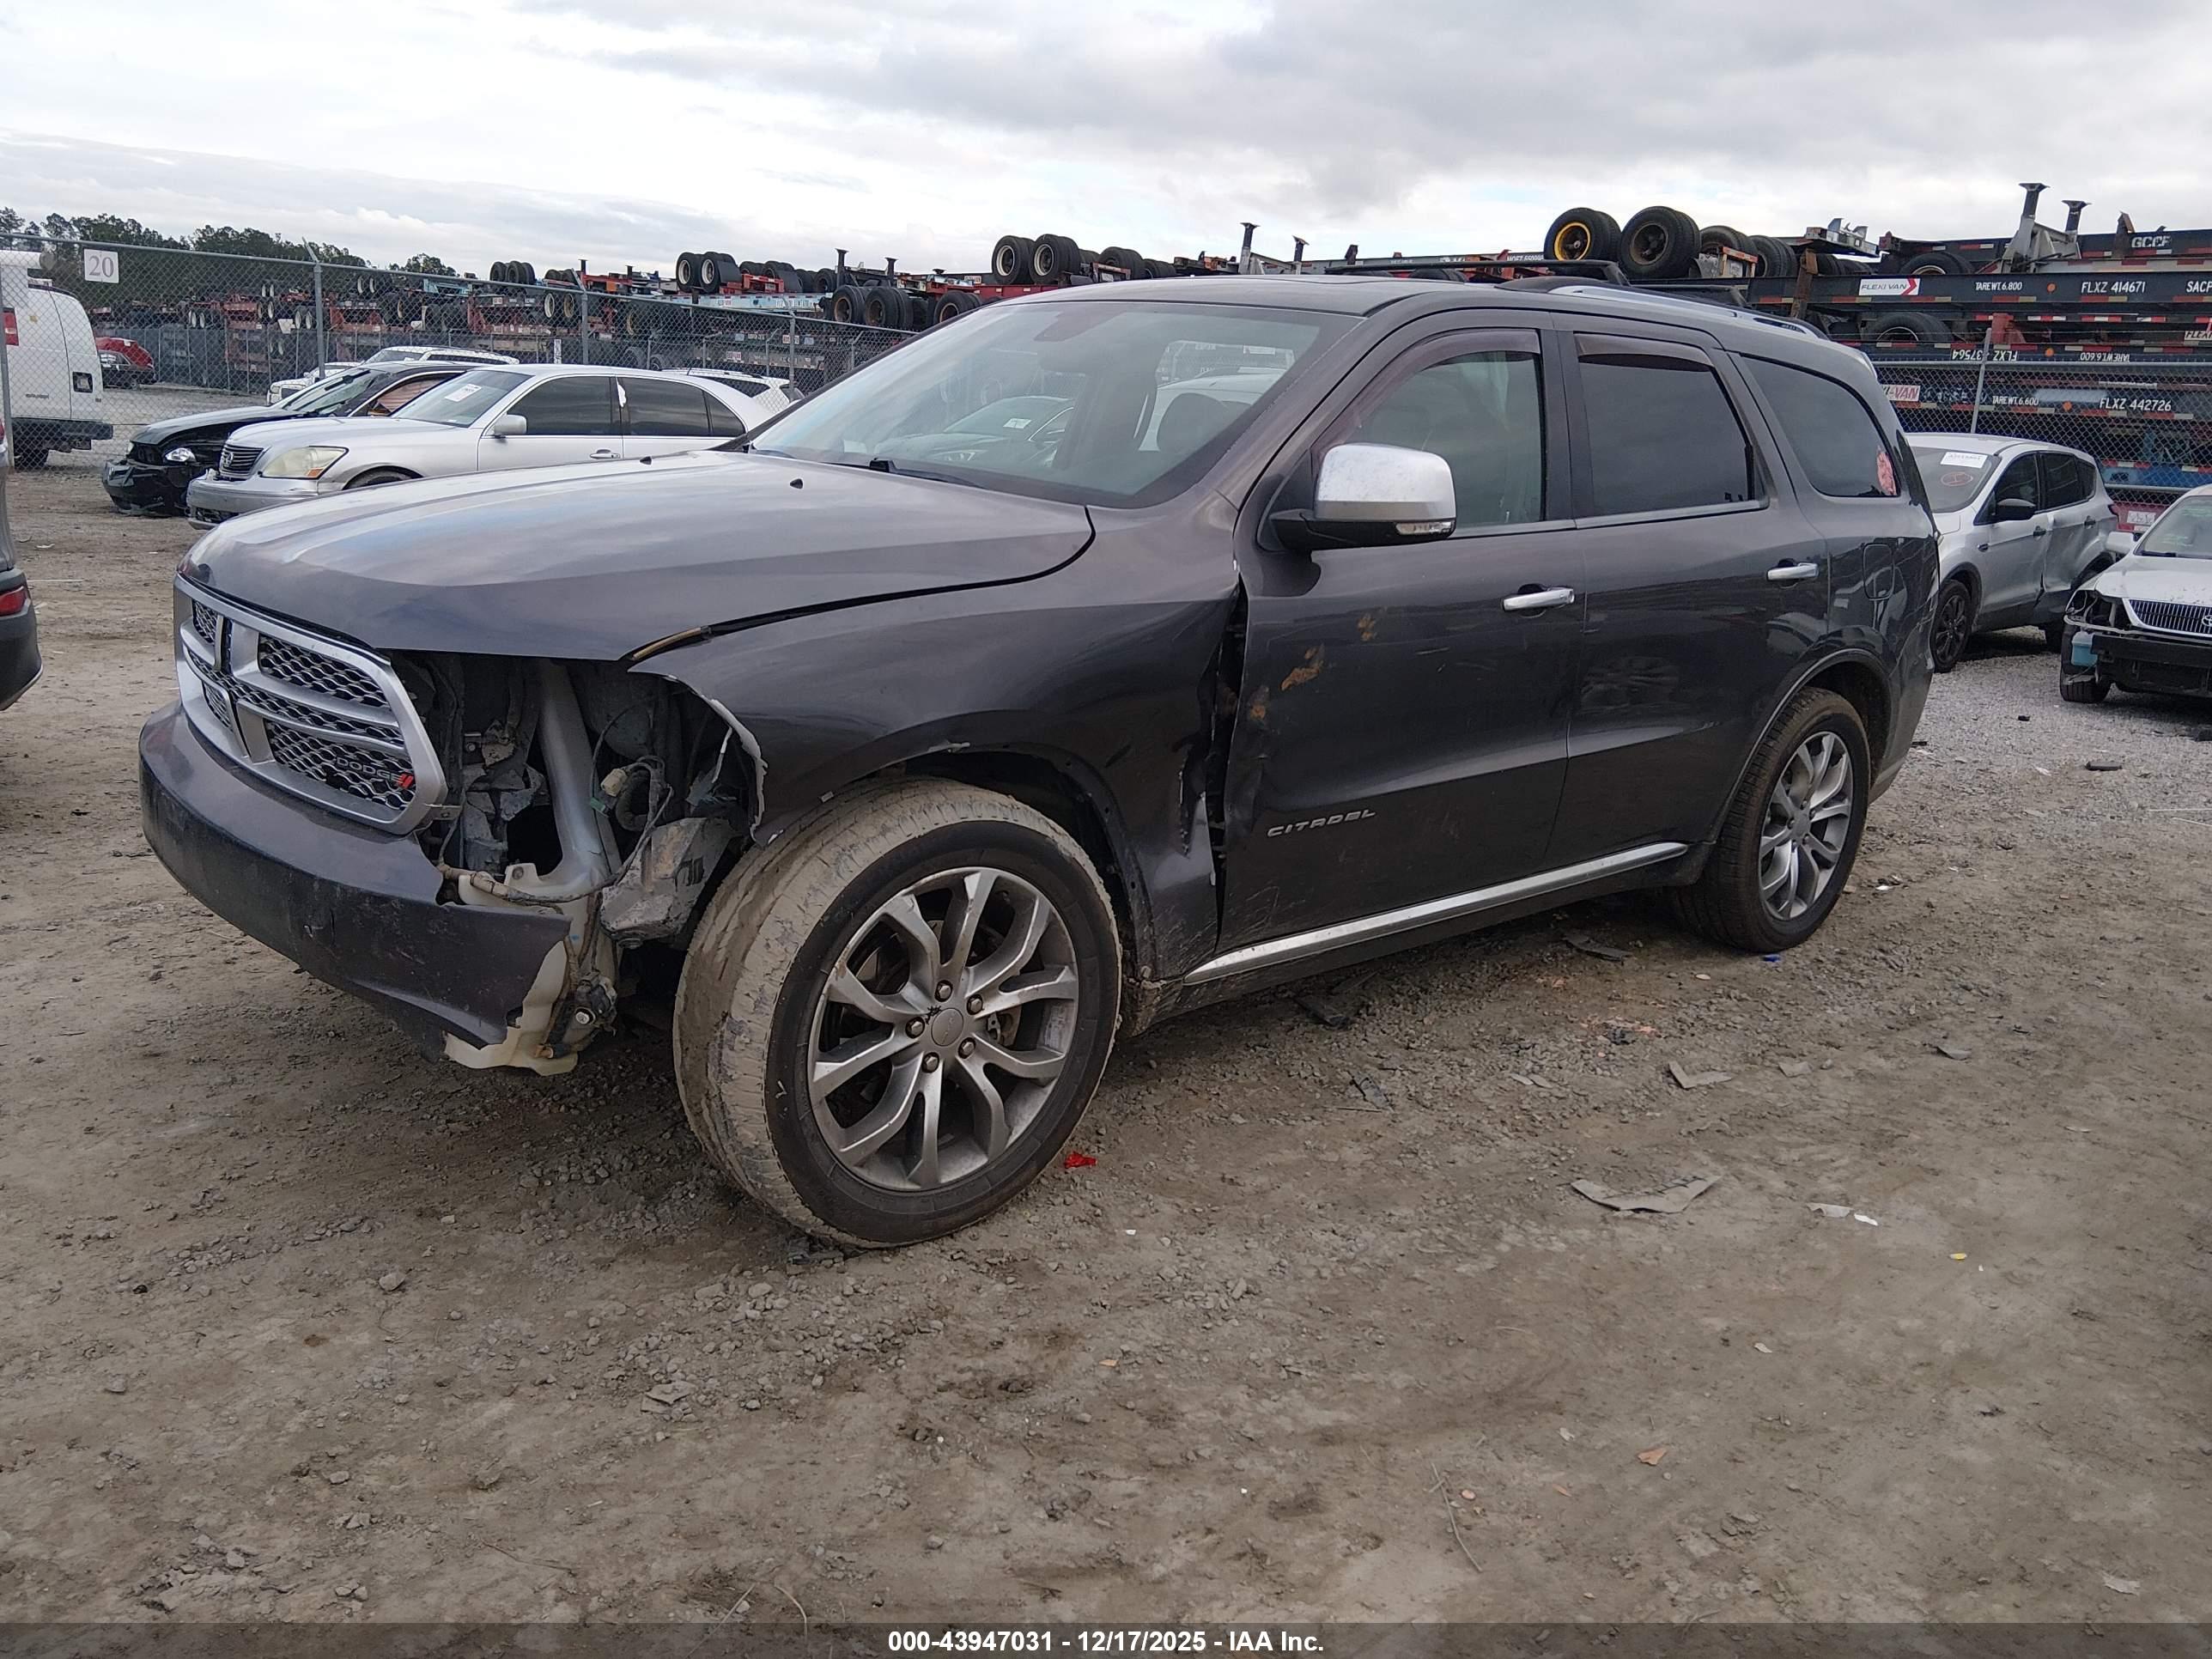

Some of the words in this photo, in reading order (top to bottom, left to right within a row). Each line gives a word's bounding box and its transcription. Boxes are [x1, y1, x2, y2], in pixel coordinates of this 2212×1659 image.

[88, 255, 114, 278] 20
[2081, 281, 2108, 294] FLXZ
[2111, 281, 2146, 294] 414671
[1992, 349, 2018, 362] FLXZ
[2099, 398, 2127, 410] FLXZ
[2129, 398, 2172, 412] 442726
[1267, 809, 1376, 837] CITADEL
